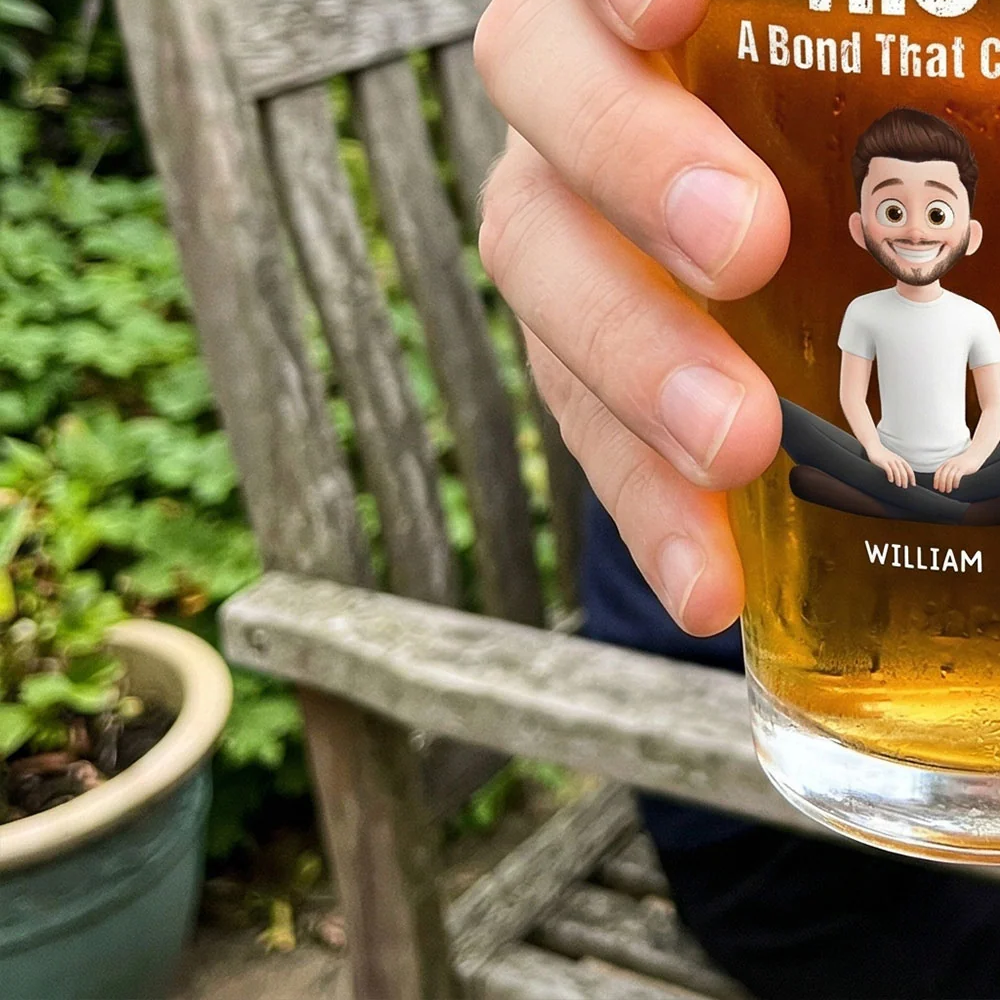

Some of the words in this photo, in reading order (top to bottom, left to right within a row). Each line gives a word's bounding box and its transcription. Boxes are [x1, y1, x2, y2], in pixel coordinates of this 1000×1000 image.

[738, 20, 759, 63] A
[768, 24, 862, 74] Bond
[875, 33, 965, 79] That
[864, 540, 983, 573] WILLIAM
